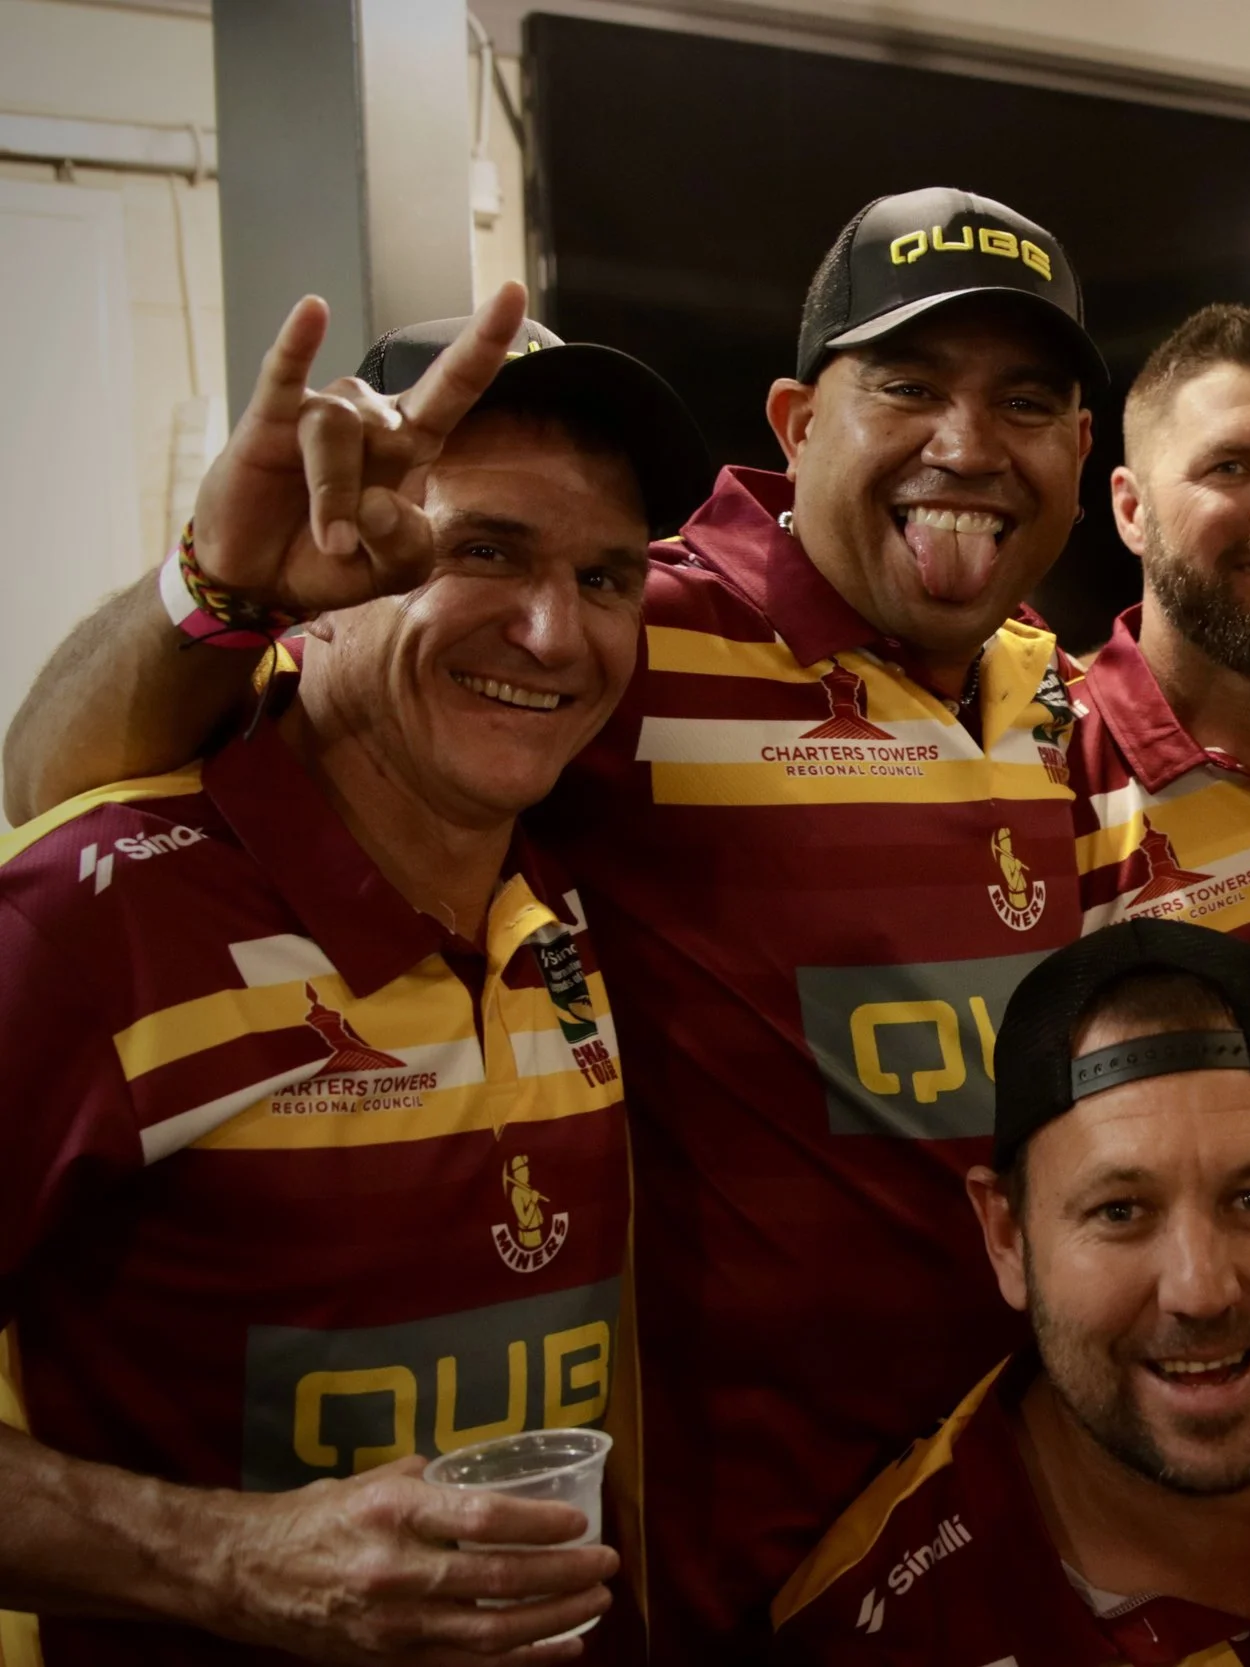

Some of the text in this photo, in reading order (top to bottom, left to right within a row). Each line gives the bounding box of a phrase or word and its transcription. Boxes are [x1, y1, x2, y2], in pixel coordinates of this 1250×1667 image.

[890, 225, 1053, 282] QUBE
[761, 745, 939, 762] CHARTERS TOWERS
[786, 765, 924, 777] REGIONAL COUNCIL
[992, 885, 1044, 928] MINERS
[1189, 892, 1246, 919] COUNCIL
[274, 1072, 437, 1097] ARTERS TOWERS
[272, 1096, 423, 1114] REGIONAL COUNCIL
[496, 1219, 566, 1271] MINERS
[887, 1513, 973, 1596] Sinalli
